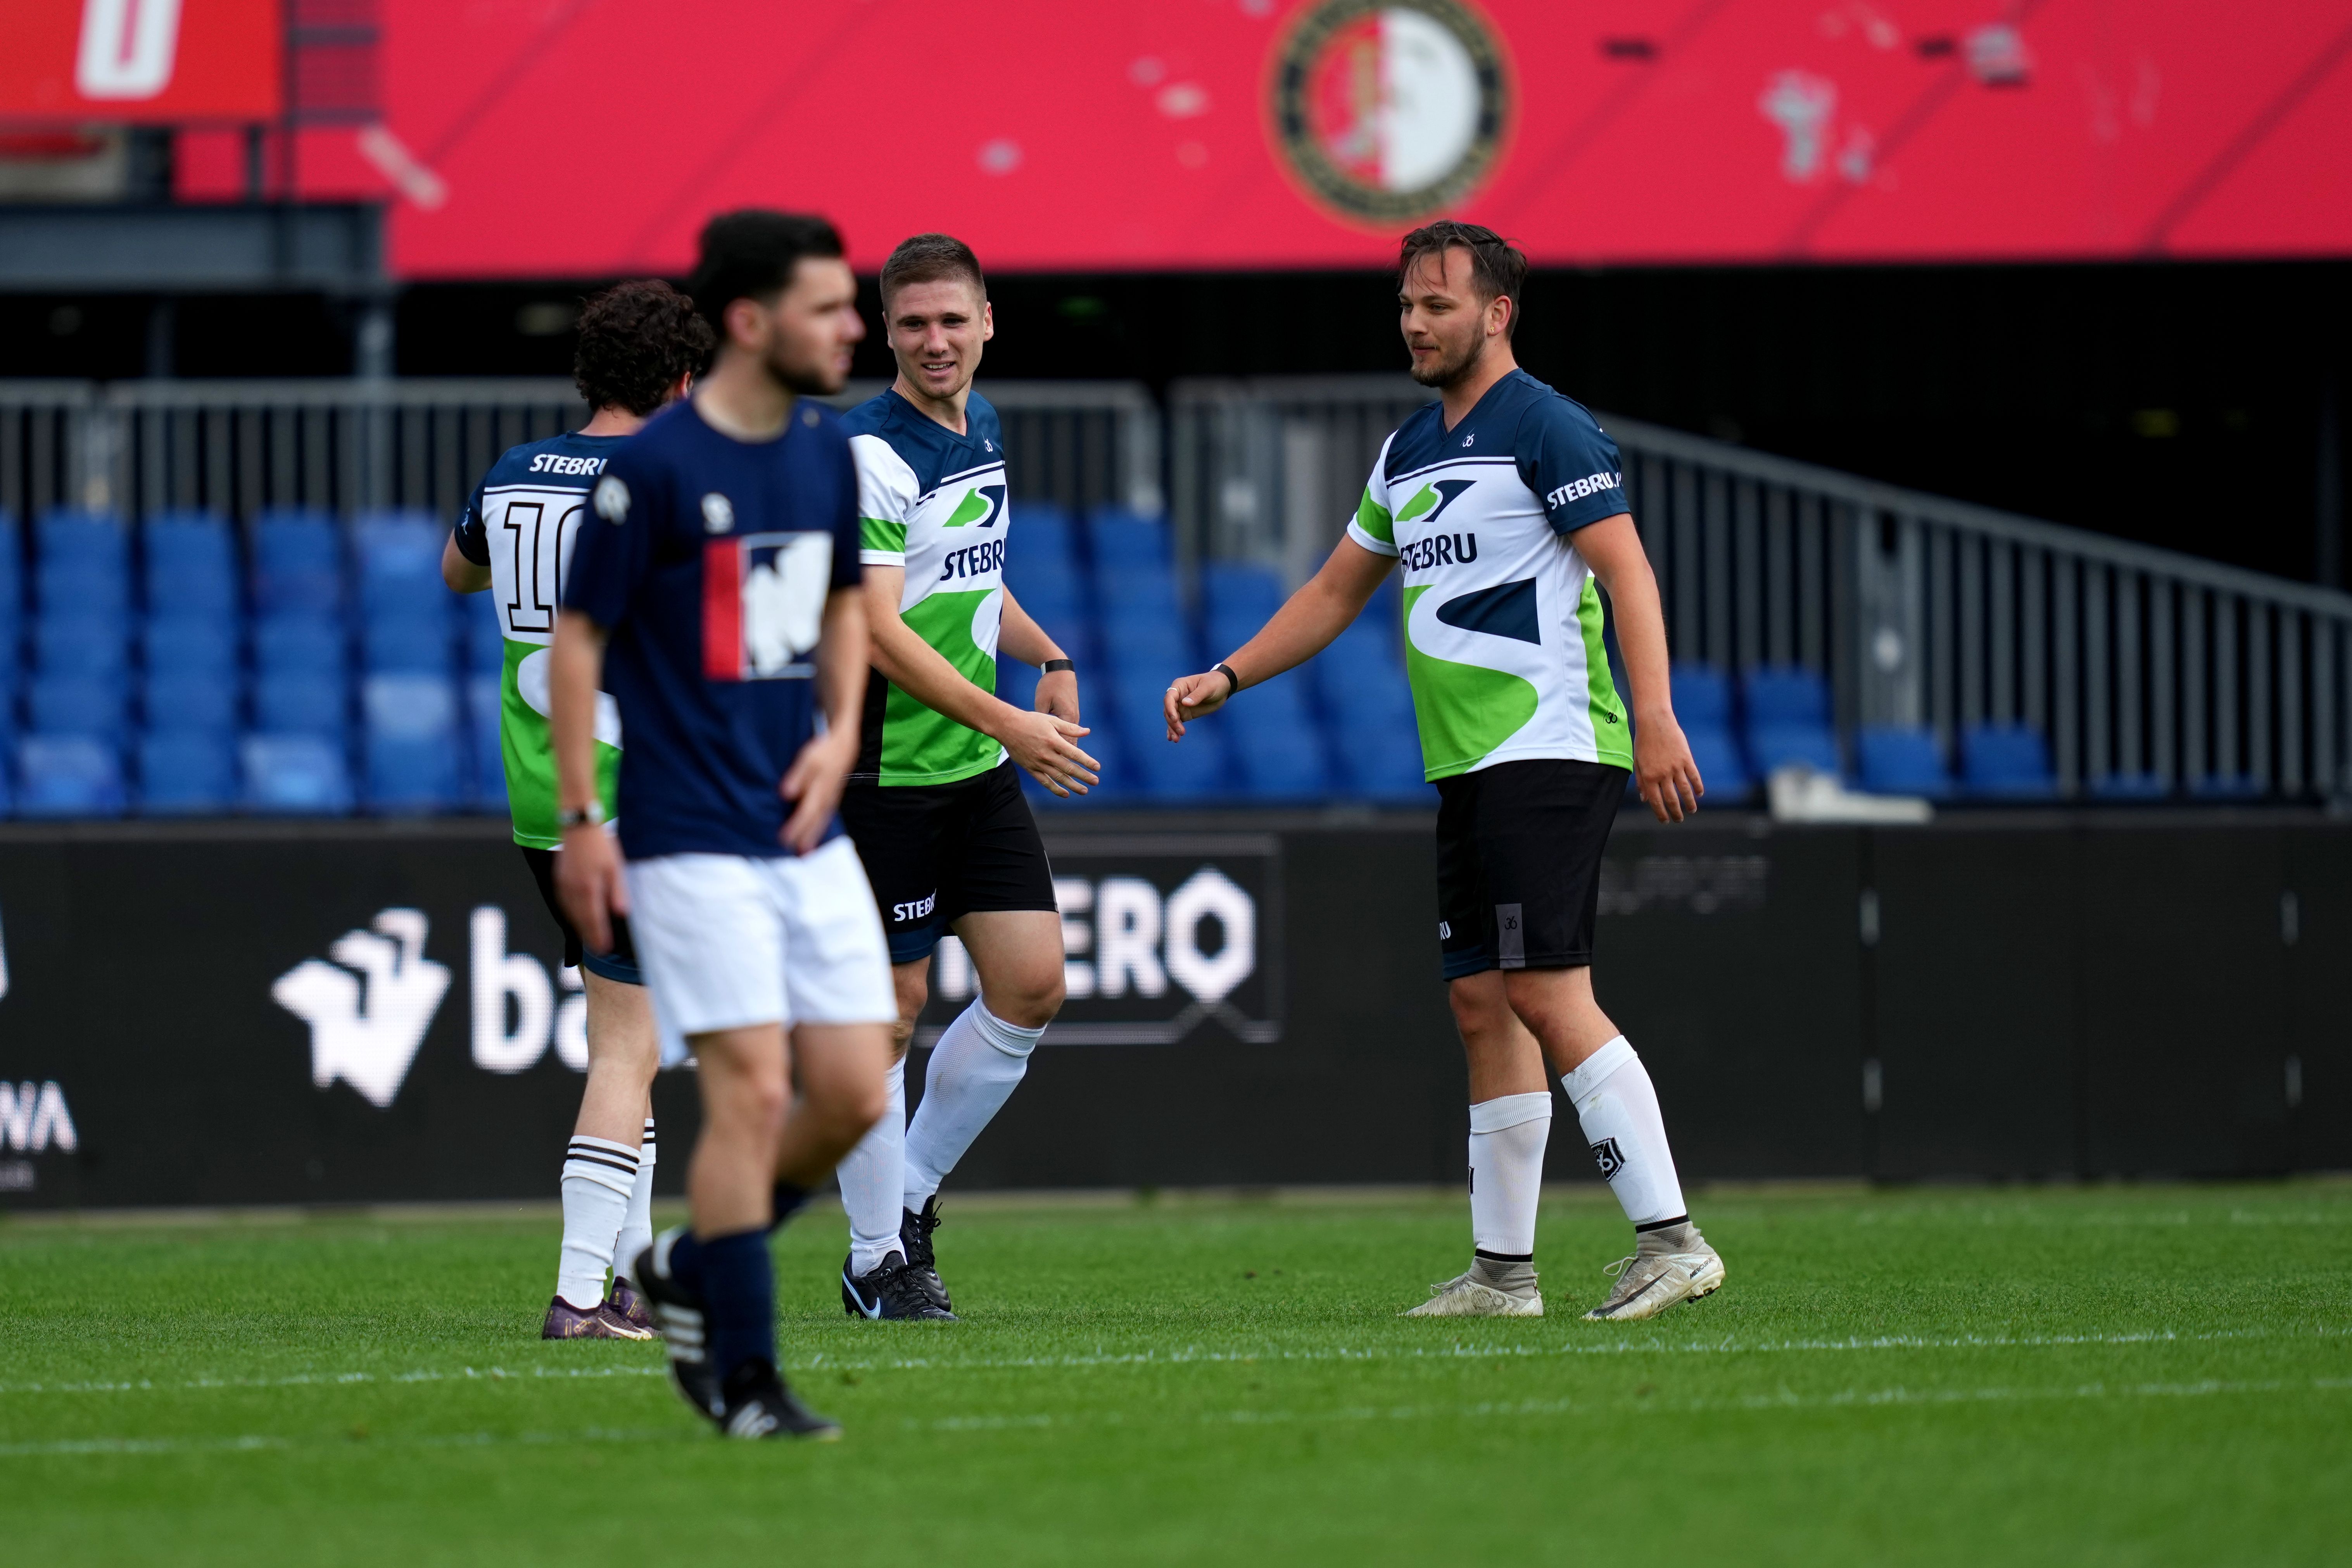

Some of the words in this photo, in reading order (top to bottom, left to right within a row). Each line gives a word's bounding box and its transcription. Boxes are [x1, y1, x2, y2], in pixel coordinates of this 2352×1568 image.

[939, 537, 1006, 581] STEBR
[1400, 533, 1477, 573] STEBRU
[893, 888, 936, 921] STEBR
